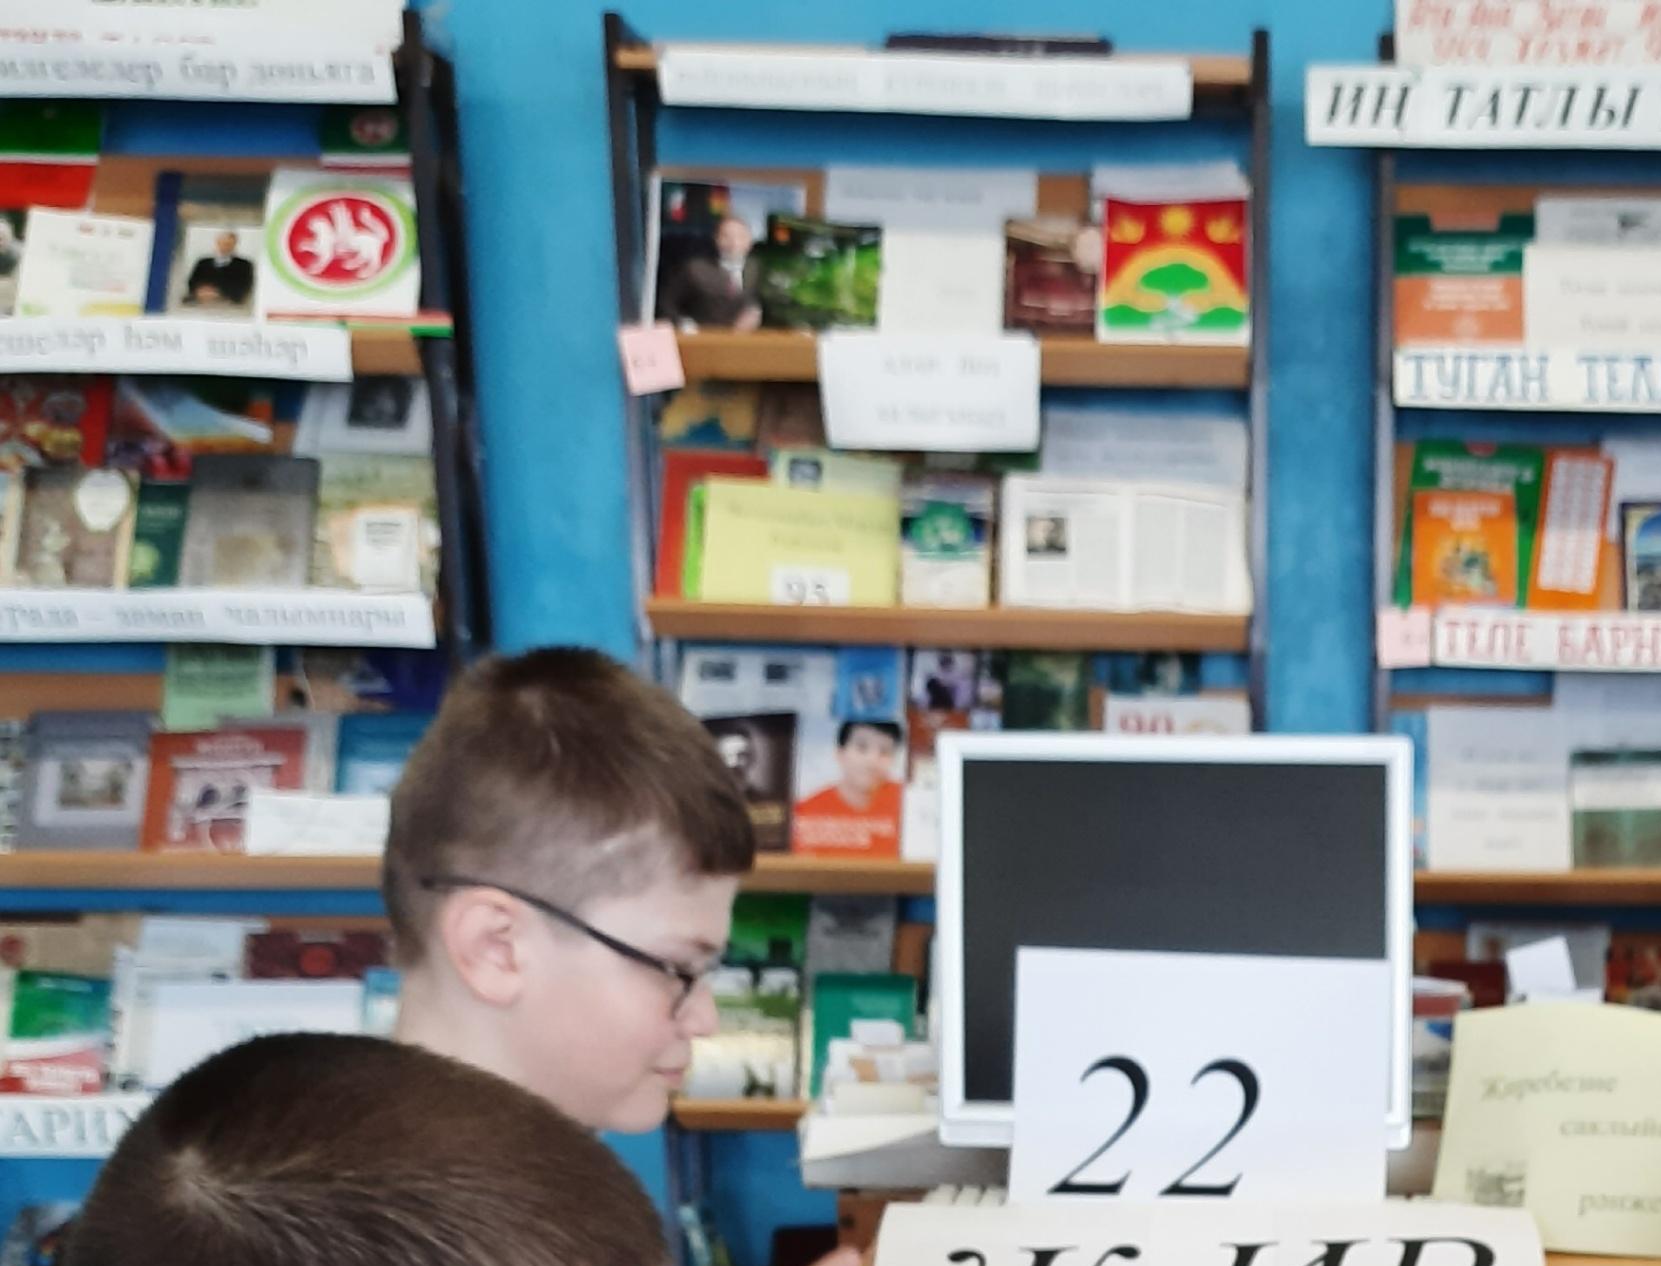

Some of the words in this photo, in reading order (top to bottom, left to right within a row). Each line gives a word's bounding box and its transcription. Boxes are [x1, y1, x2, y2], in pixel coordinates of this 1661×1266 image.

[1444, 82, 1641, 132] ТАТЛЫ
[1404, 354, 1550, 400] ТУГАН
[1046, 1055, 1261, 1198] 22
